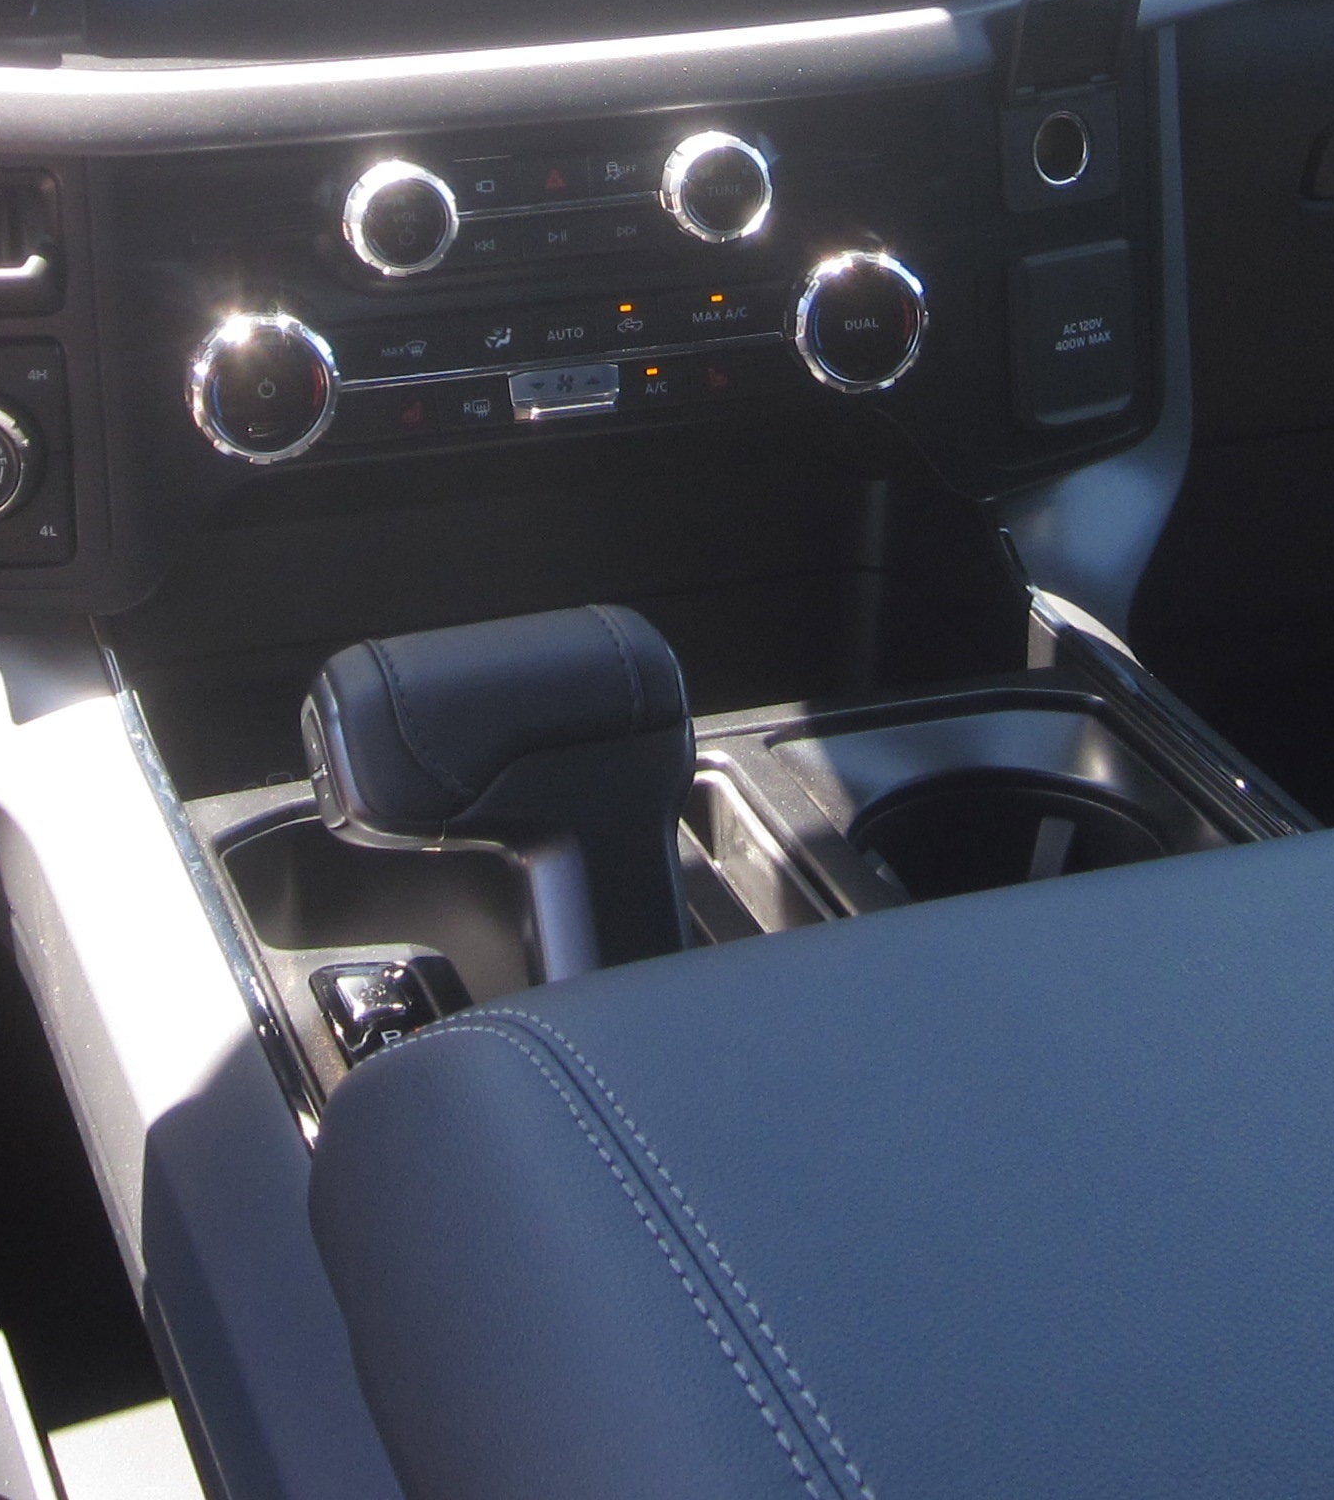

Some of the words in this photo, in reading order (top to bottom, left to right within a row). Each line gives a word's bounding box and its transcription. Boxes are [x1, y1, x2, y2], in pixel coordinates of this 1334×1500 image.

[692, 310, 722, 324] MAX
[724, 307, 748, 322] A/C
[844, 318, 879, 332] DUAL
[1063, 323, 1077, 335] AC
[1079, 317, 1103, 331] 120V
[547, 328, 584, 342] AUTO
[1055, 337, 1086, 351] 400W
[1089, 331, 1112, 345] MAX
[27, 369, 47, 381] 4H
[645, 381, 668, 395] A/C
[39, 525, 58, 537] 4L
